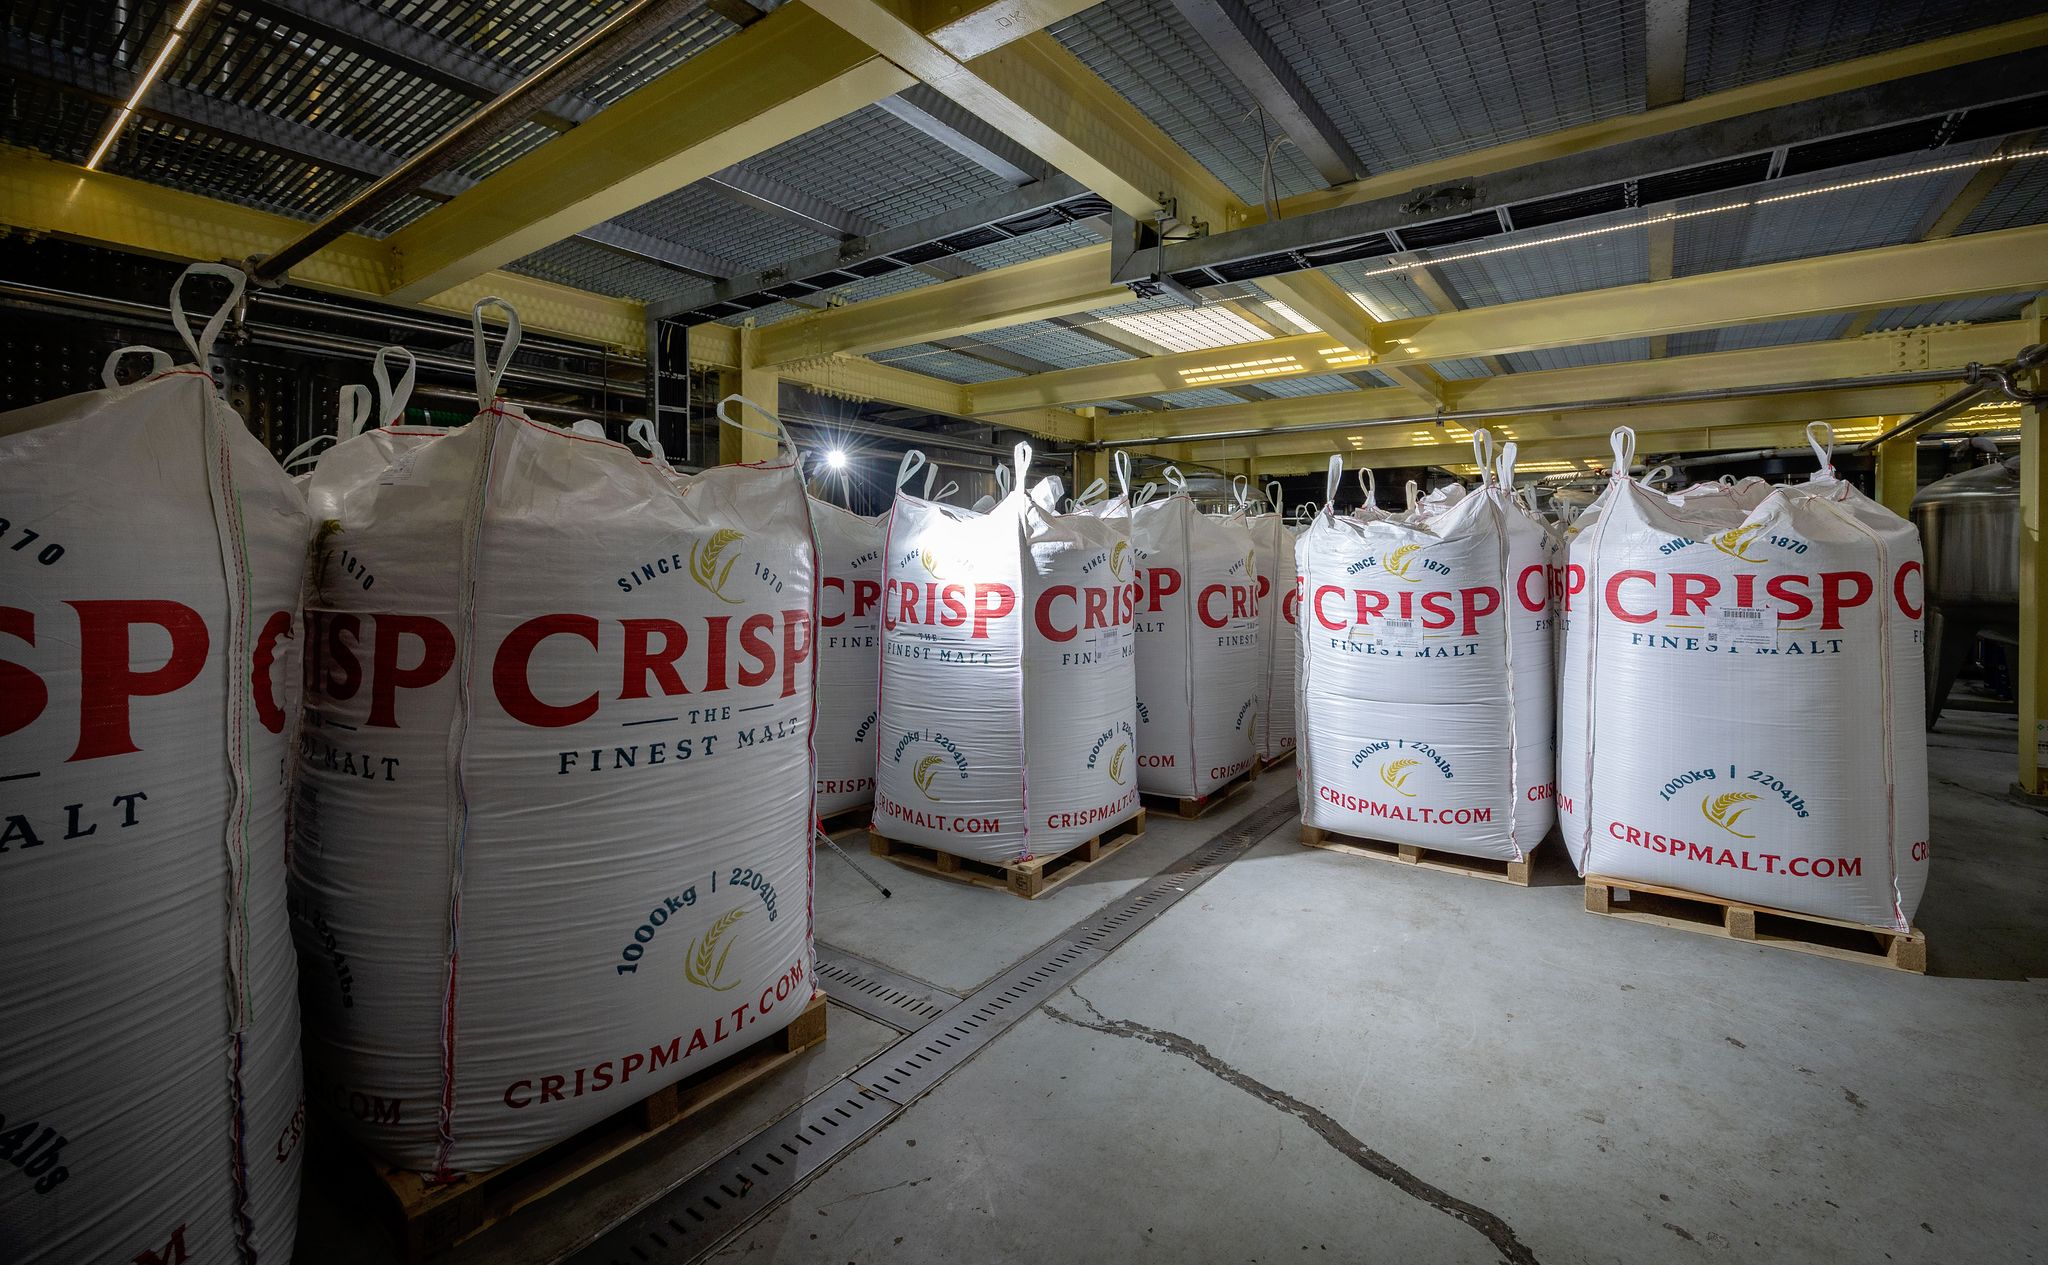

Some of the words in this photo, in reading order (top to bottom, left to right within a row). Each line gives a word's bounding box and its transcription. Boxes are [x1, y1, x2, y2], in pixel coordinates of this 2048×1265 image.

[851, 551, 878, 569] SINCE
[900, 549, 919, 568] SINCE
[1082, 553, 1107, 574] SINCE
[1659, 535, 1696, 555] SINC
[1769, 535, 1808, 554] 1870
[341, 551, 374, 590] 1870
[618, 554, 683, 594] SINCE
[755, 562, 785, 595] 1870
[1346, 556, 1377, 576] SINCE
[1423, 558, 1452, 577] 1870
[885, 578, 1016, 639] CRISP
[1314, 585, 1501, 637] CRISP
[1604, 568, 1874, 630] CRISP
[493, 609, 810, 728] CRISP
[887, 642, 931, 660] FINEST
[939, 649, 992, 664] MALT
[1061, 652, 1096, 665] FIN
[688, 706, 731, 724] THE
[559, 735, 718, 775] FINEST
[737, 716, 799, 749] MALT
[894, 731, 920, 763] 1000kg
[934, 733, 968, 779] 2204lbs
[1086, 728, 1114, 769] 1000kg
[1351, 740, 1391, 769] 1000kg
[1410, 741, 1454, 780] 2204lbs
[1320, 786, 1492, 825] CRISPMALT.COM
[1659, 767, 1716, 801] 1000kg
[1747, 770, 1810, 818] 2204lbs
[1609, 821, 1863, 878] CRISPMALT.COM
[618, 885, 697, 975] 1000kg
[730, 868, 779, 922] 2204lbs
[504, 958, 804, 1109] CRISPMALT.COM
[0, 1113, 69, 1195] 4lbs
